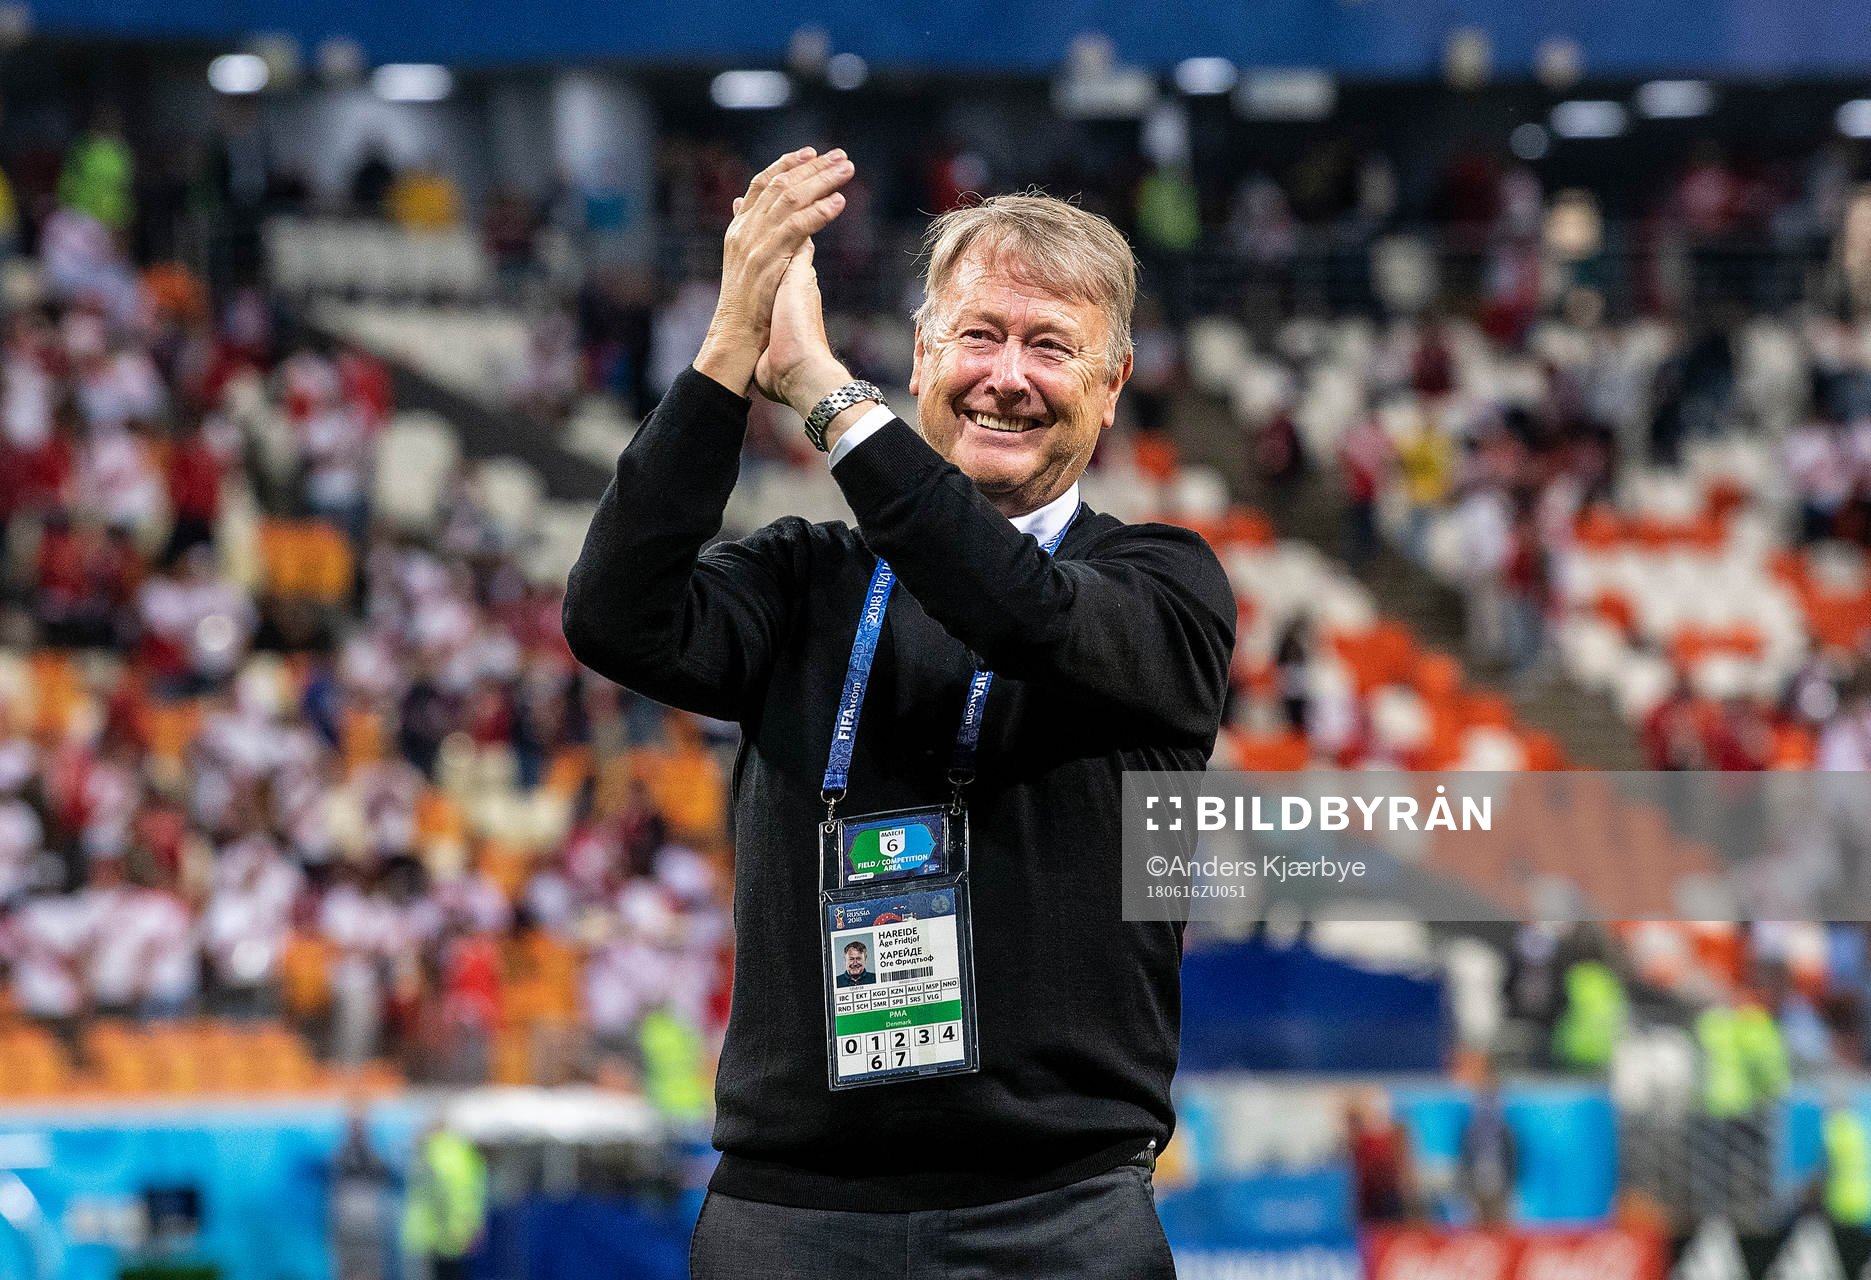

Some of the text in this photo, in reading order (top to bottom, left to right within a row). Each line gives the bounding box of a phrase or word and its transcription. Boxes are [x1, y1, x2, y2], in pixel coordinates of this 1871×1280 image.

[873, 572, 892, 593] FIFA
[866, 596, 882, 624] 2018
[838, 682, 861, 740] FIFA.com
[887, 839, 898, 852] 6
[857, 860, 876, 870] FIELD
[881, 854, 928, 865] COMPETITION
[883, 864, 902, 872] AREA
[846, 910, 870, 918] RUSSIA
[878, 927, 918, 940] HAREIDE
[894, 935, 920, 946] Fridtjof
[880, 947, 923, 960] ХАРЕЙДЕ
[895, 955, 934, 967] Фридтьоф
[942, 980, 957, 988] NNO
[909, 995, 921, 1003] SRS
[889, 1009, 907, 1019] PMA
[885, 1019, 912, 1028] Denmark
[845, 1025, 955, 1054] 0 1 2 3 4
[871, 1051, 906, 1070] 6 7
